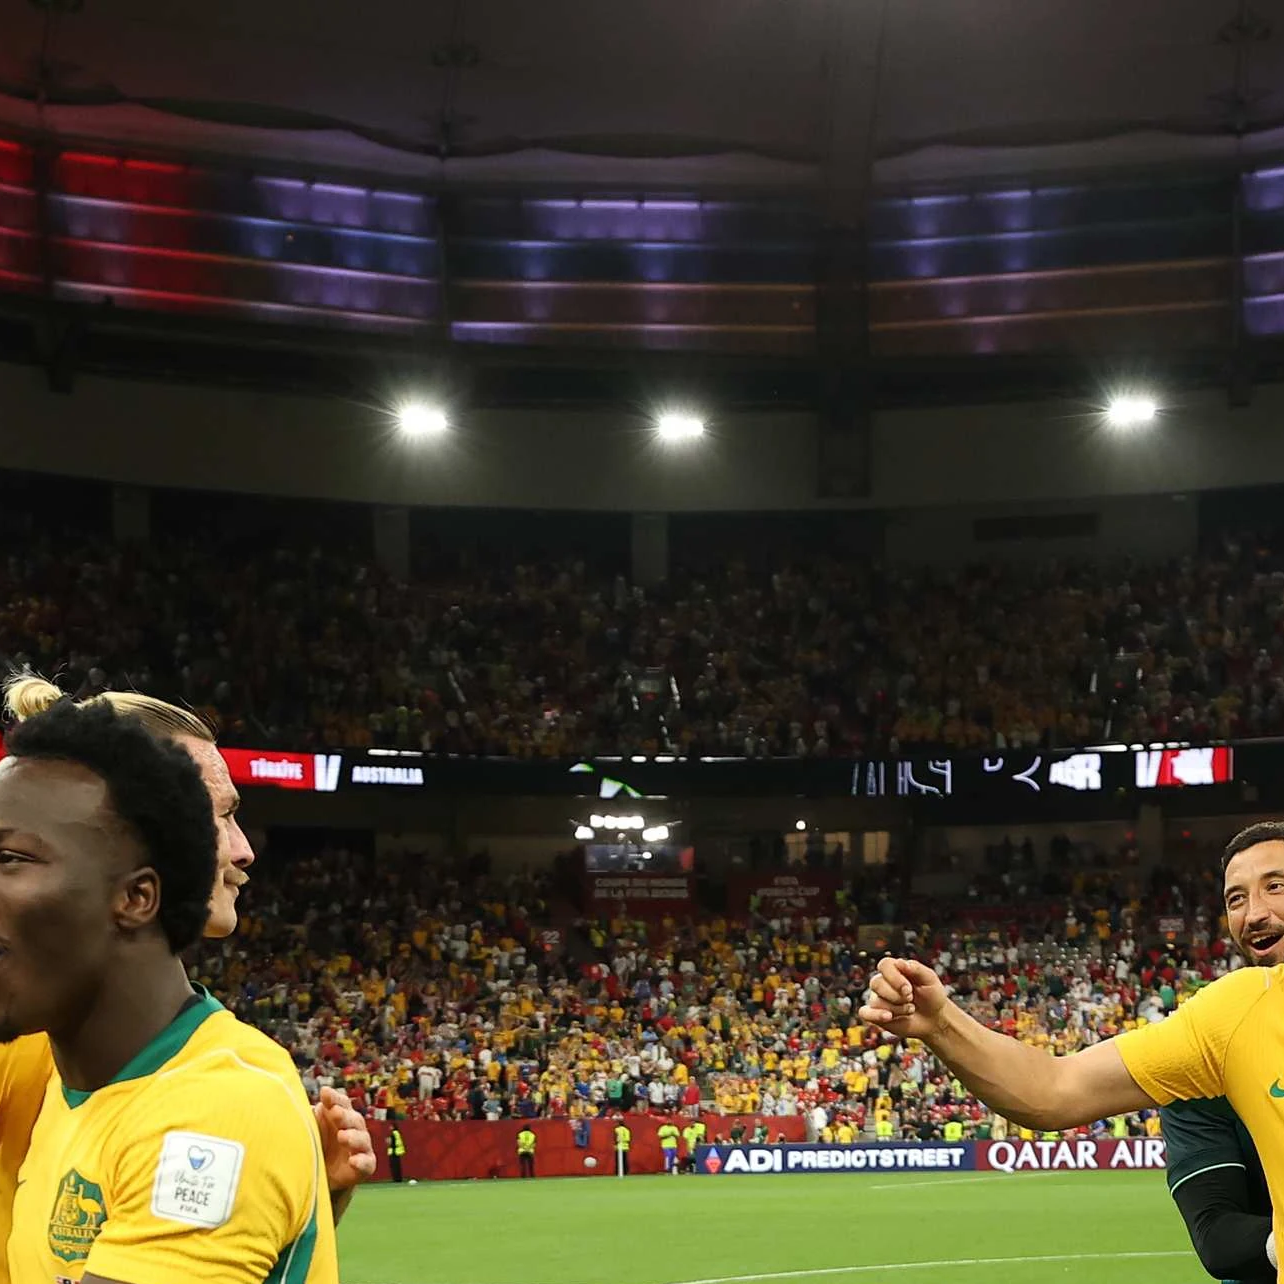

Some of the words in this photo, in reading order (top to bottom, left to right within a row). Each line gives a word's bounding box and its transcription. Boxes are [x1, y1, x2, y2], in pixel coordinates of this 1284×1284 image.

[352, 765, 424, 785] AUSTRALIA
[724, 1148, 783, 1173] ADI
[787, 1148, 965, 1169] PREDICTSTREET
[987, 1140, 1099, 1173] QATAR
[1110, 1139, 1167, 1168] AIR
[174, 1187, 211, 1206] PEACE
[179, 1204, 198, 1215] FIFA
